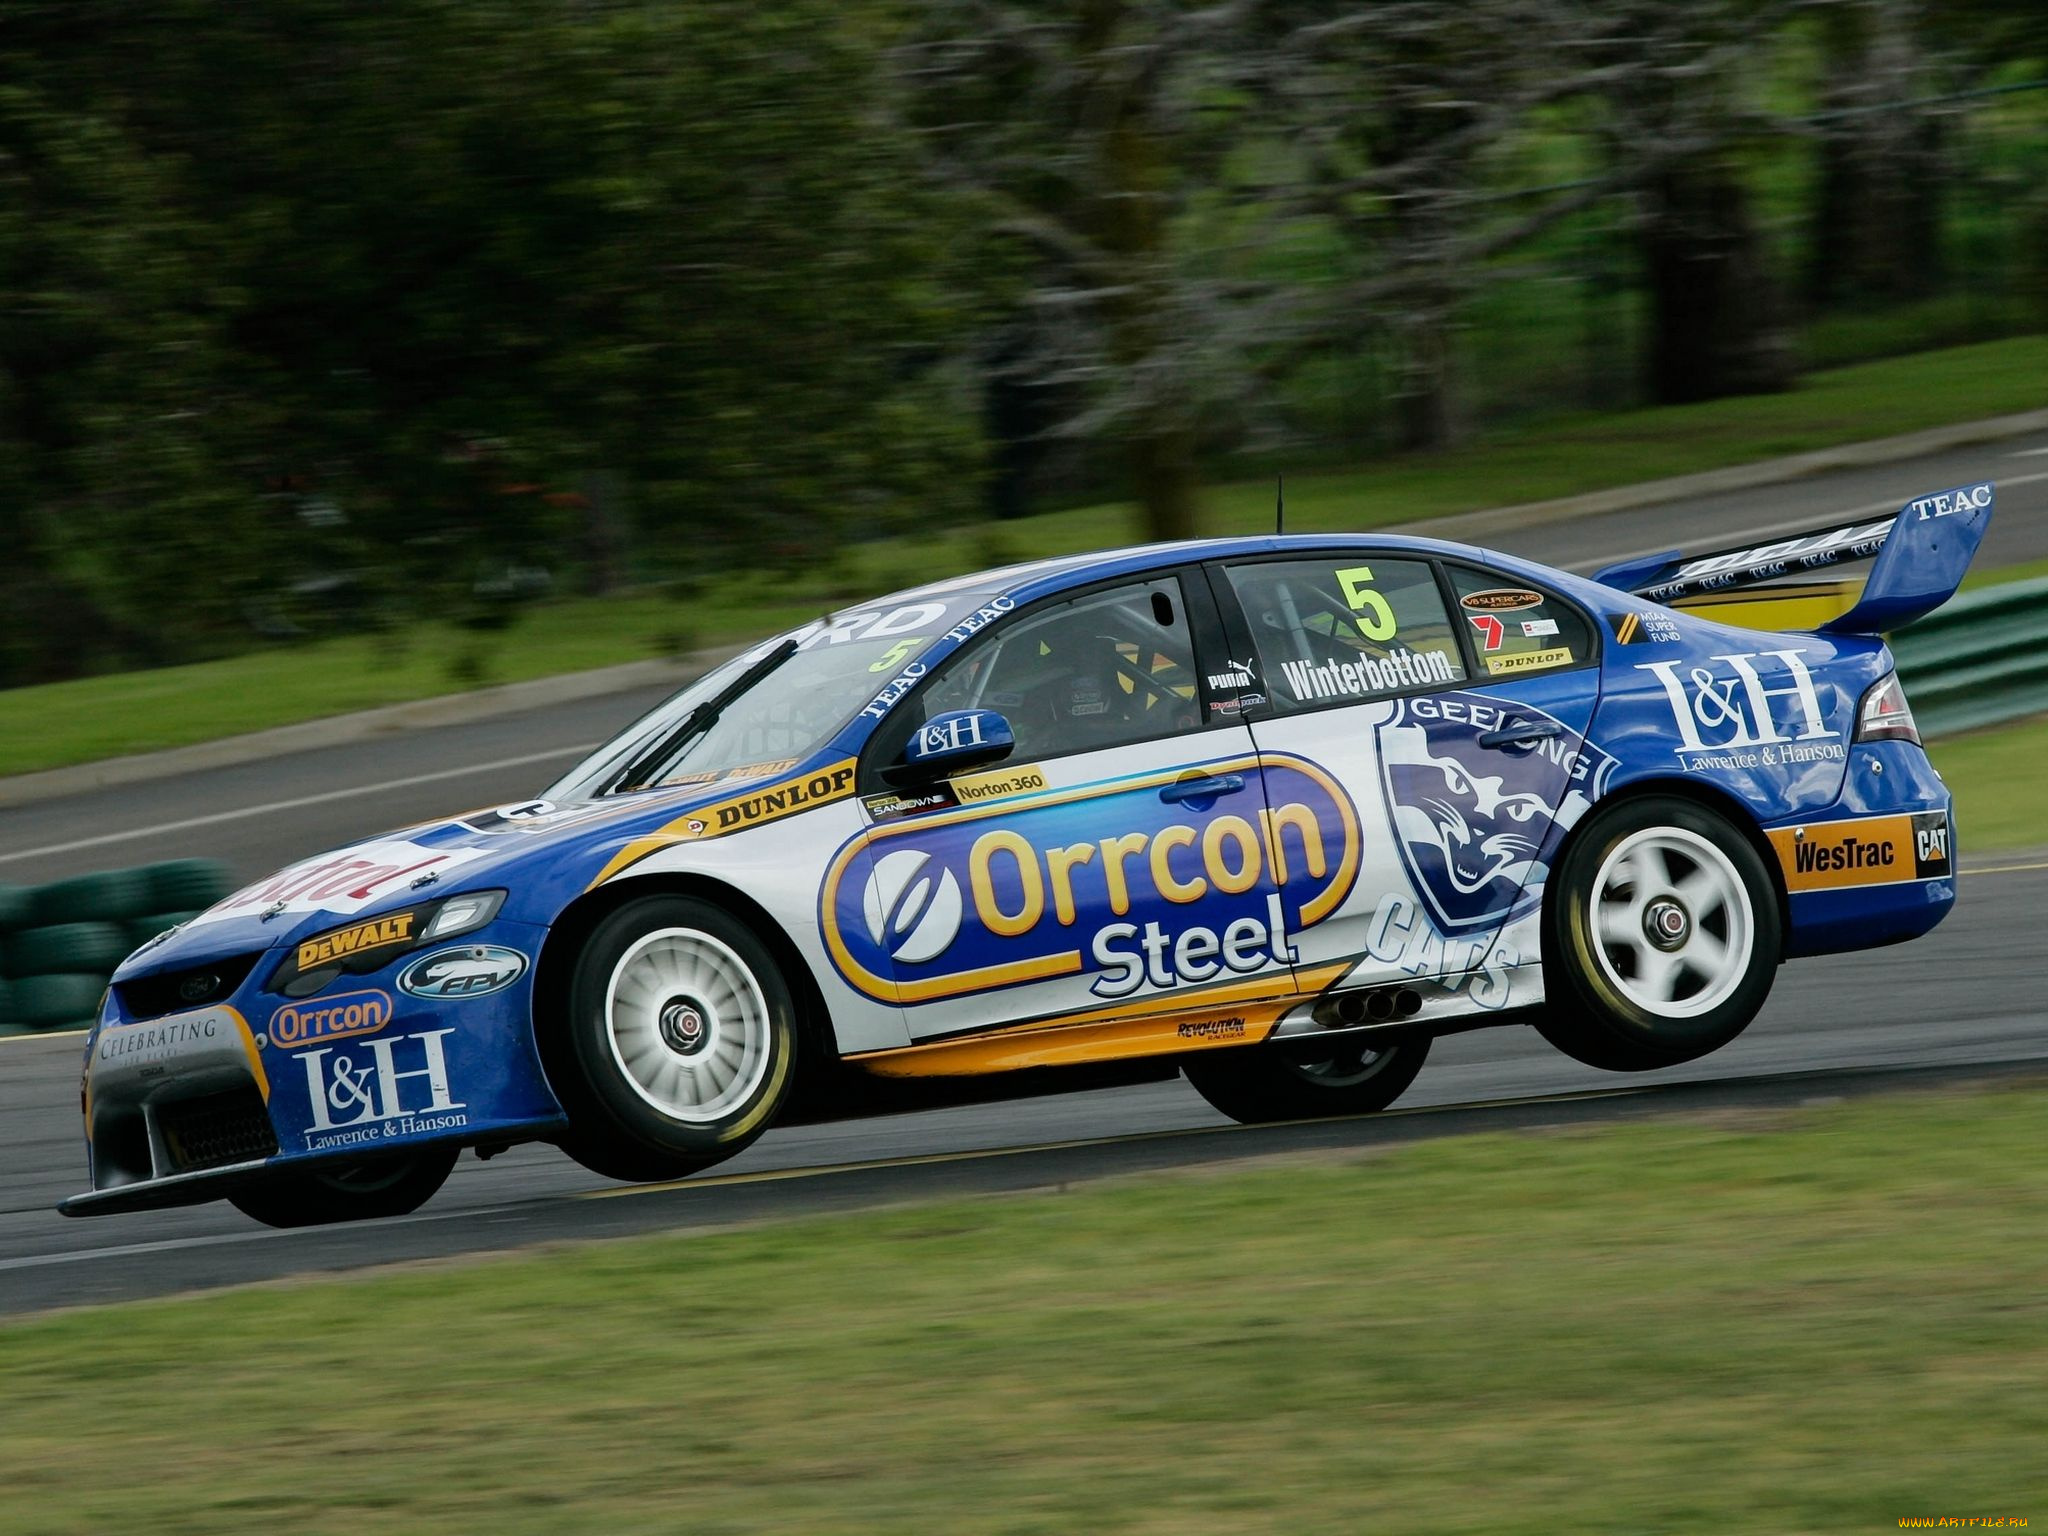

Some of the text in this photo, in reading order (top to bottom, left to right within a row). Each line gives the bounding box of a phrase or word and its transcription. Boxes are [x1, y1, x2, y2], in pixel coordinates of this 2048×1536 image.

[1912, 485, 1992, 521] TEAC
[1750, 562, 1787, 579] TEAC
[1800, 550, 1837, 568] TEAC
[1649, 584, 1686, 601] TEAC
[1700, 573, 1737, 590] TEAC
[942, 597, 1015, 643] TEAC
[1335, 567, 1397, 642] 5
[1640, 612, 1670, 622] MTAA
[1645, 621, 1678, 632] SUPER
[1650, 631, 1681, 643] FUND
[868, 637, 924, 674] 5
[1504, 652, 1564, 668] DUNLOP
[860, 662, 927, 719] TEAC
[1207, 671, 1251, 690] PUMA
[1281, 648, 1454, 701] Winterbottom
[1677, 744, 1846, 773] Lawrence & Hanson
[716, 767, 854, 829] DUNLOP
[957, 773, 1044, 800] Norton 360
[1795, 838, 1895, 874] WesTrac
[1917, 828, 1946, 862] CAT
[968, 801, 1327, 937] Orrcon
[1089, 894, 1298, 998] Steel
[1364, 891, 1522, 1010] CATS
[440, 968, 517, 993] FPV
[279, 999, 383, 1042] Orrcon
[1177, 1017, 1246, 1038] REVOLUTION
[101, 1019, 217, 1060] CELEBRATING
[305, 1113, 468, 1152] Lawrence & Hanson
